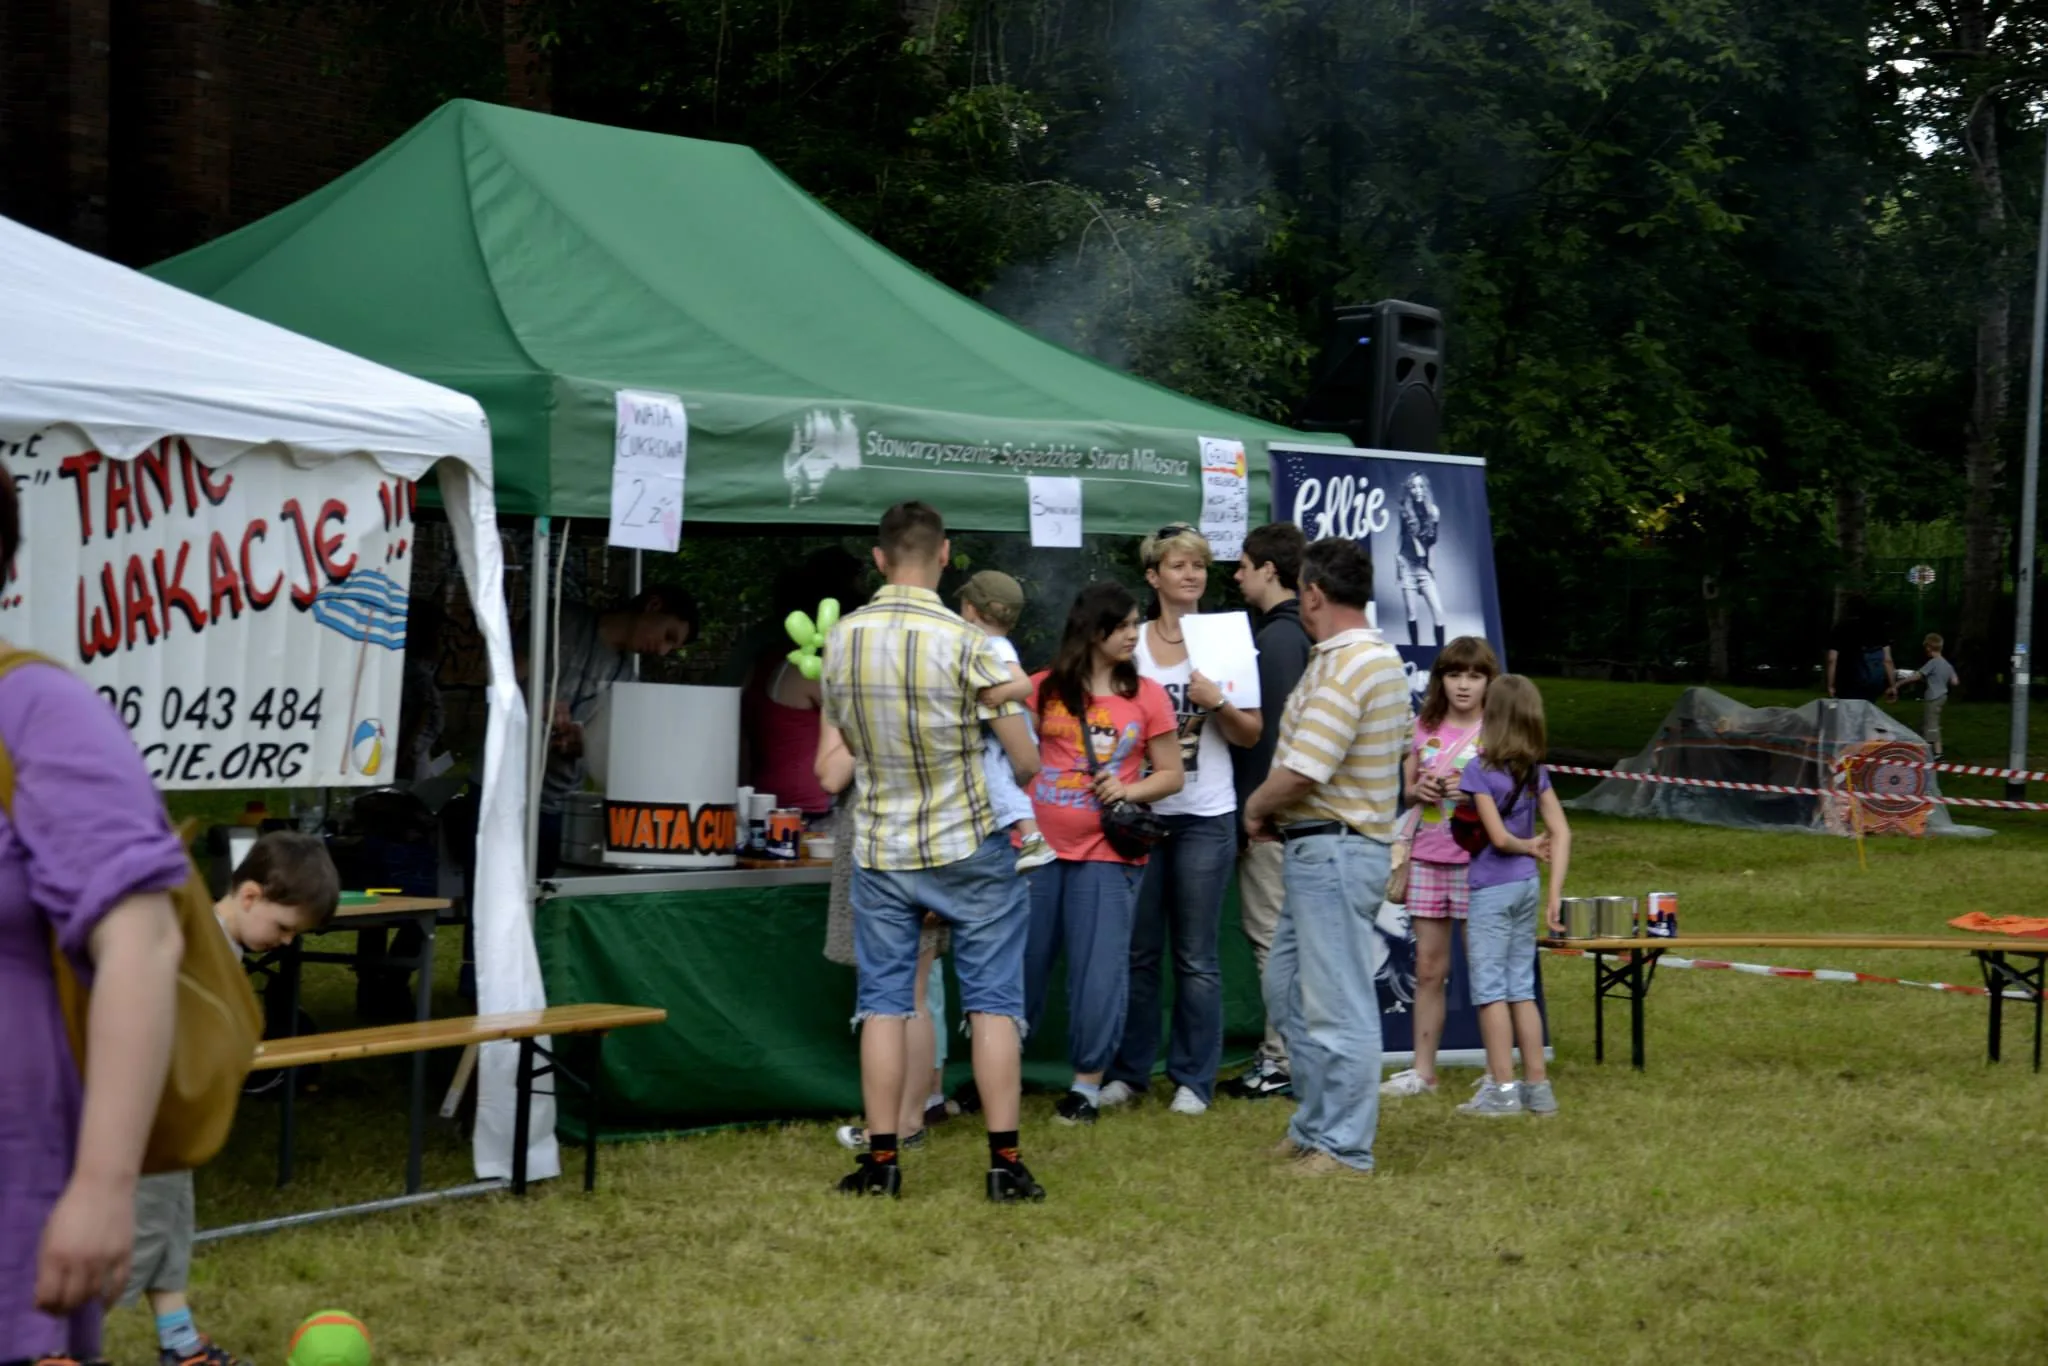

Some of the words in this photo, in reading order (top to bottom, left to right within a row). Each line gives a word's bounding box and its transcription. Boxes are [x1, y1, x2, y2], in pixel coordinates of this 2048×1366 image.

[634, 404, 673, 429] WATA
[866, 430, 995, 466] Stowarzyszenie
[1086, 446, 1130, 470] Stara
[620, 478, 645, 528] 2
[77, 498, 359, 665] WAKACJE
[161, 686, 237, 731] 043
[250, 687, 324, 731] 484
[609, 807, 692, 850] WATA
